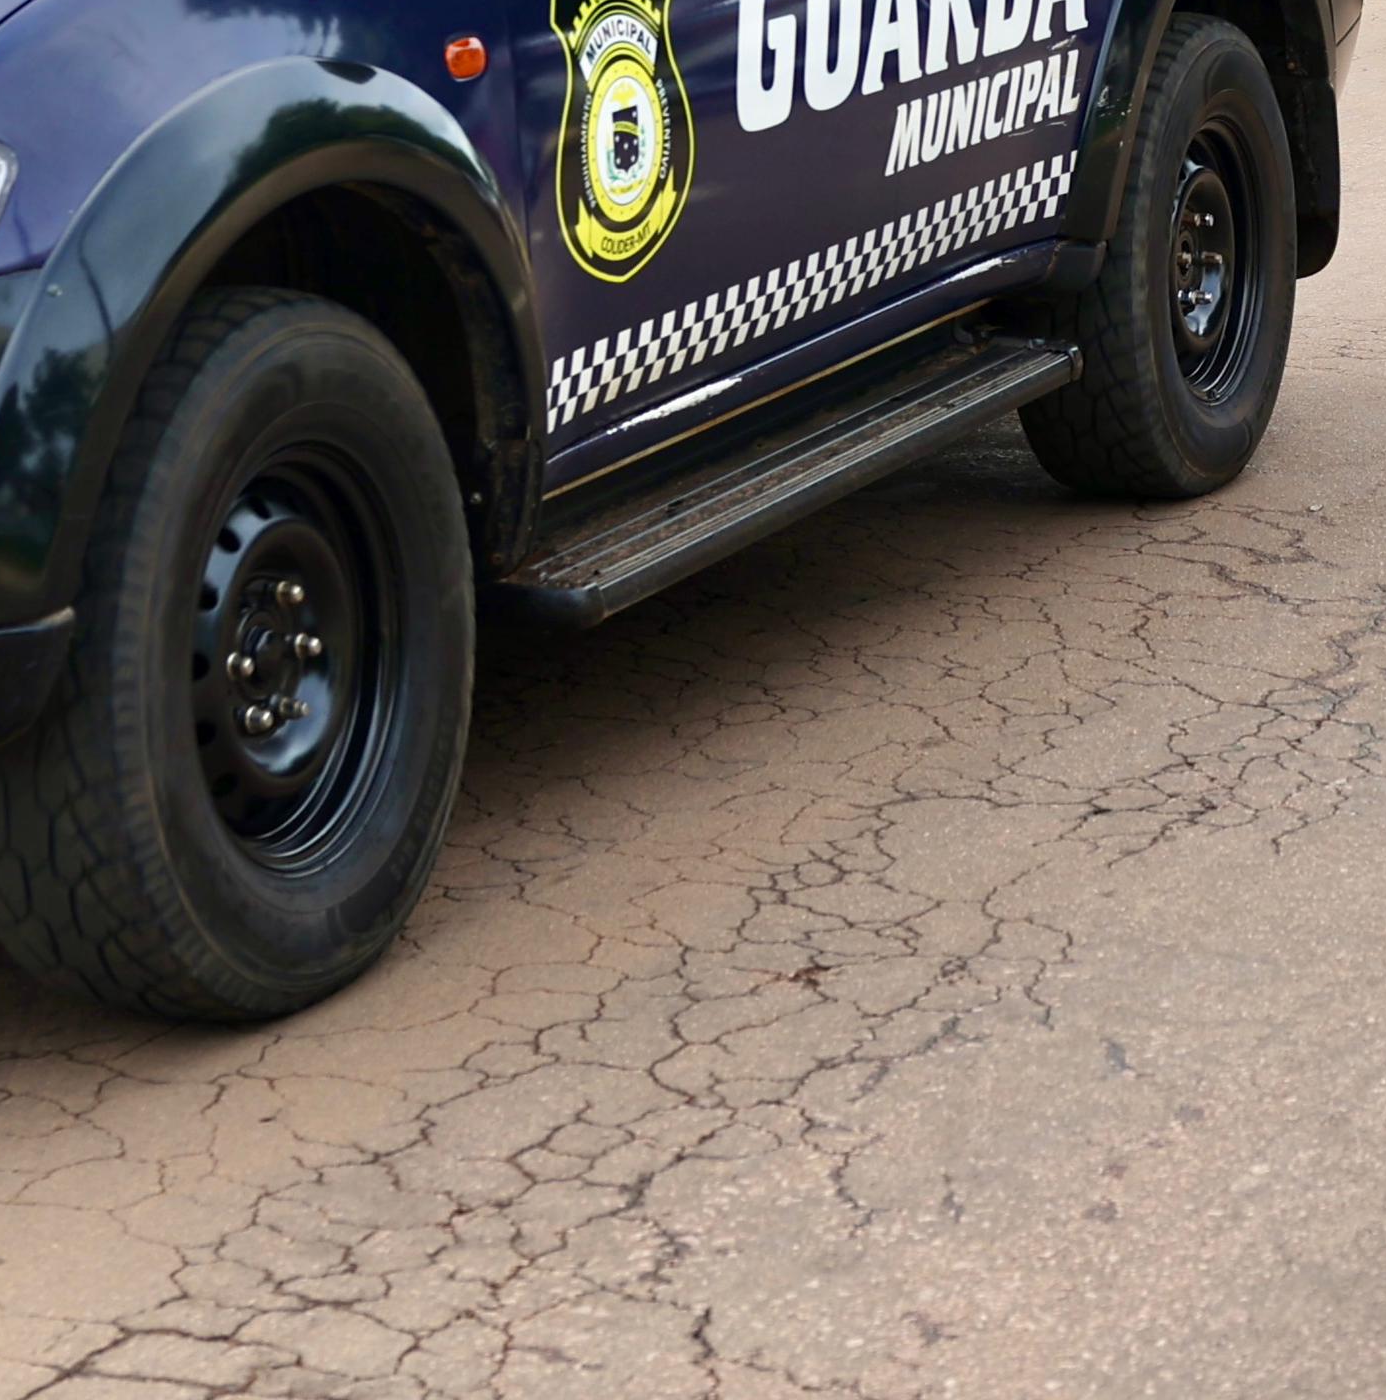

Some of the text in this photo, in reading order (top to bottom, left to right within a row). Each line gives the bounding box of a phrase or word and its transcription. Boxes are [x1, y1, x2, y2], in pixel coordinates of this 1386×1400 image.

[585, 19, 652, 65] MUNICIPAL
[656, 78, 672, 180] PREVENTIVO
[885, 48, 1080, 177] MUNICIPAL
